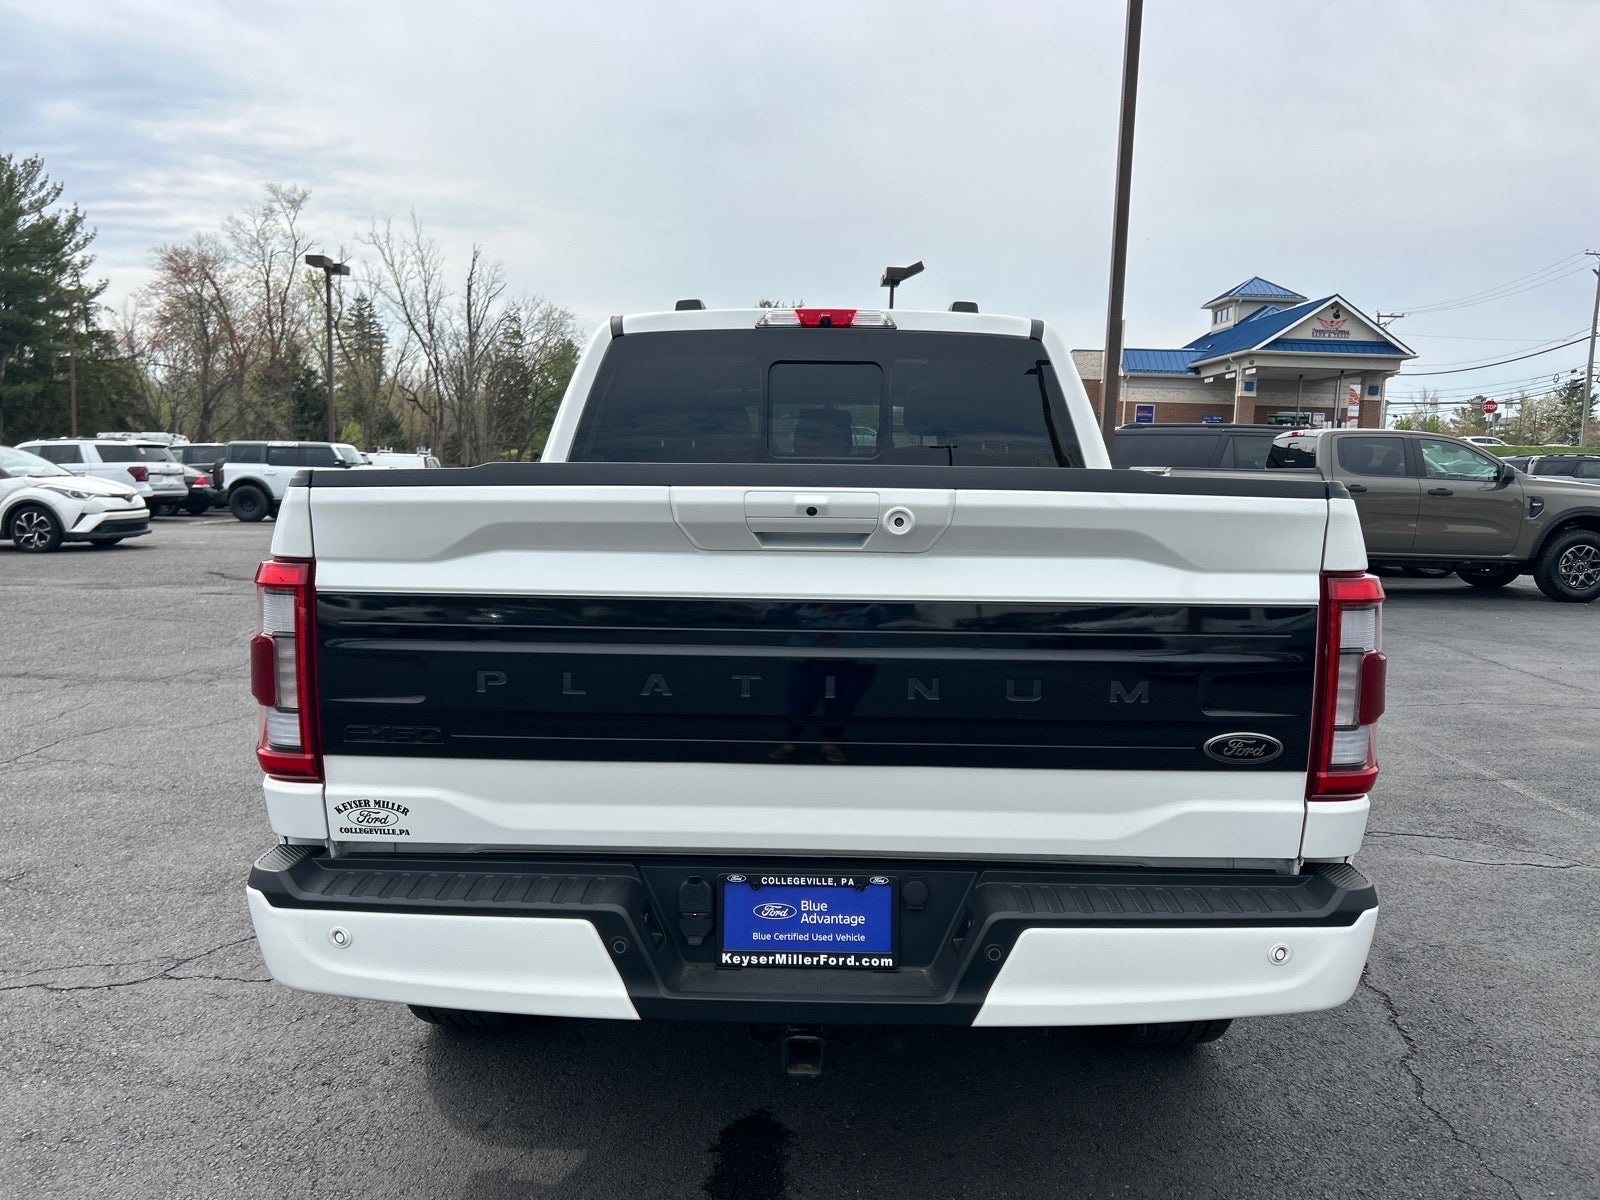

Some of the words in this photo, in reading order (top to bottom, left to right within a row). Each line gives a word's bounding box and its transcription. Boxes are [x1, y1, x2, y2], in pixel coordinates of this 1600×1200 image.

[475, 669, 1150, 704] PLATINUM
[1224, 739, 1266, 756] Ford
[334, 799, 371, 815] KEYSER
[373, 799, 409, 816] MILLER
[356, 810, 389, 825] Ford
[761, 876, 836, 887] COLLEGEVILLE,
[841, 877, 855, 886] PA
[761, 904, 789, 917] Ford
[801, 900, 828, 912] Blue
[800, 913, 866, 926] Advantage
[752, 932, 771, 940] Blue
[774, 932, 809, 941] Certified
[812, 933, 833, 941] Used
[835, 933, 866, 942] Vehicle
[721, 953, 893, 967] KeyserMillerFord.com
